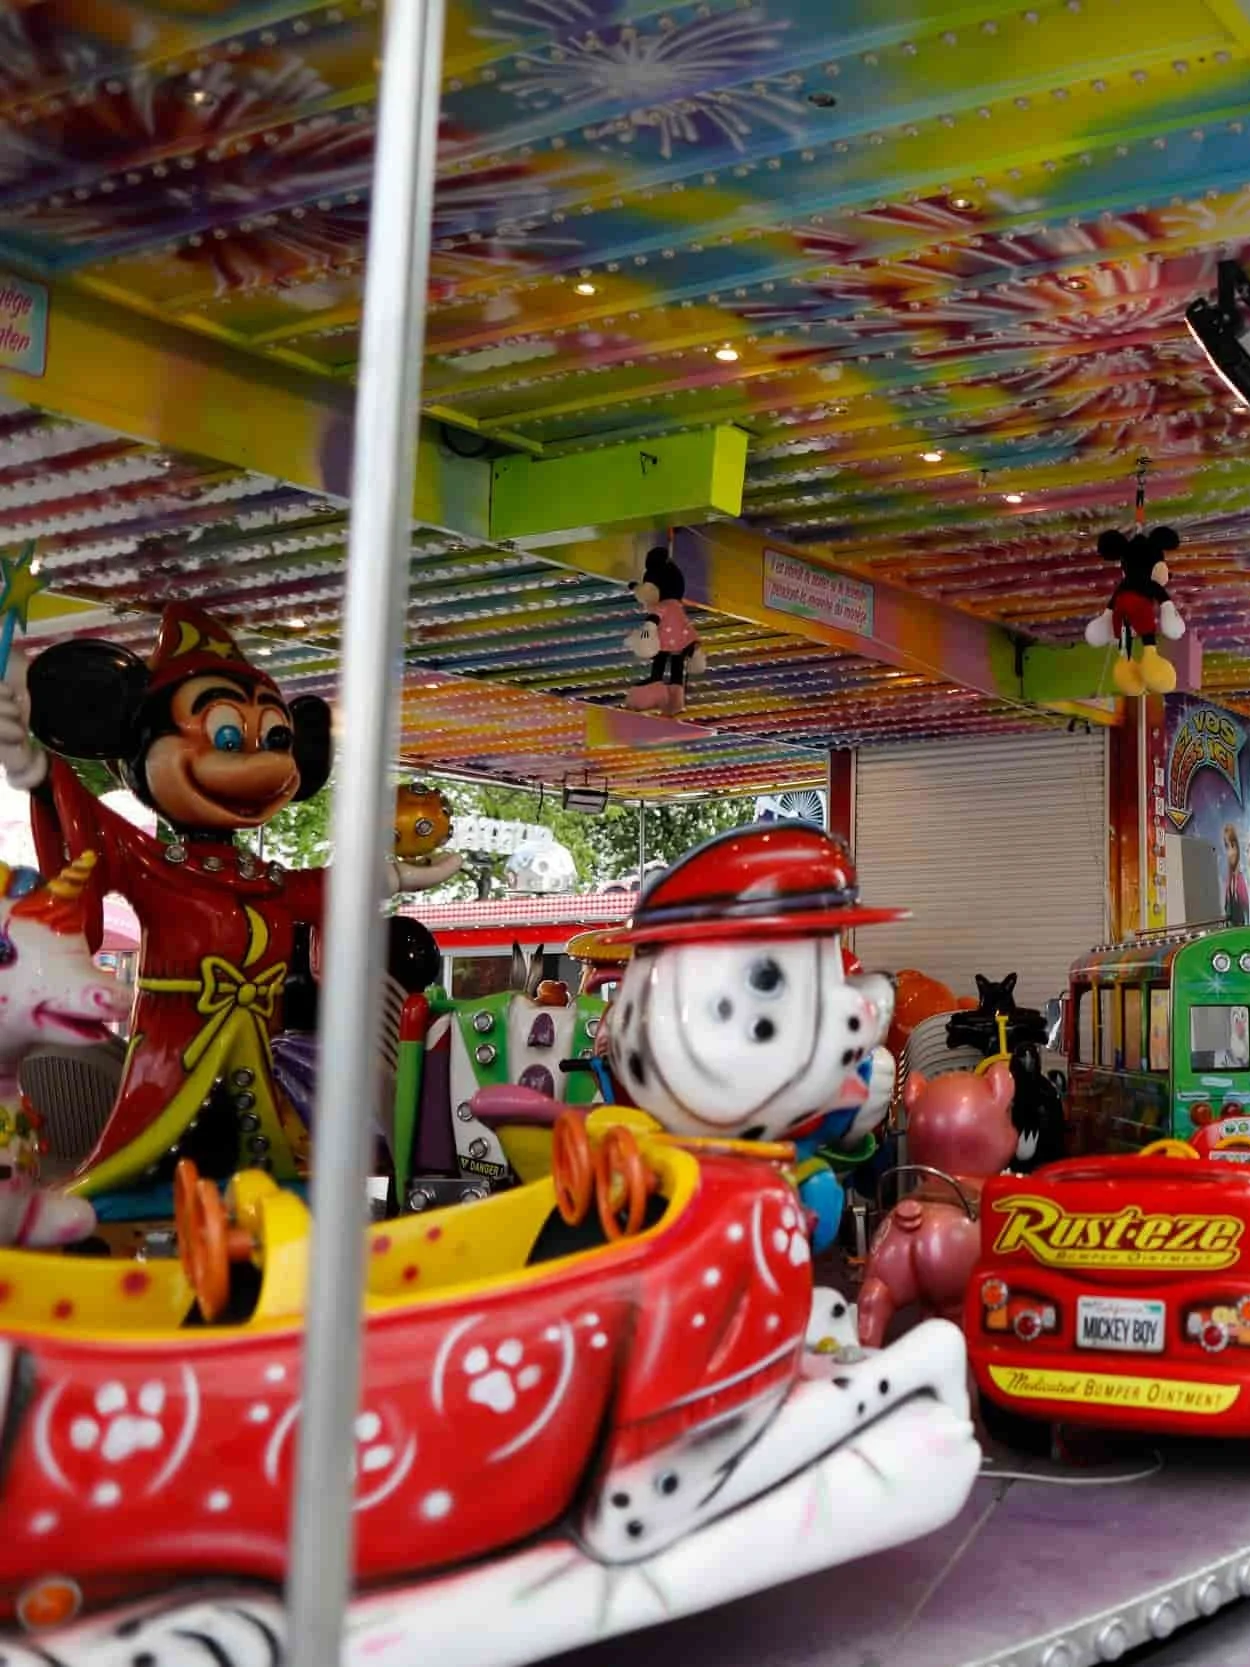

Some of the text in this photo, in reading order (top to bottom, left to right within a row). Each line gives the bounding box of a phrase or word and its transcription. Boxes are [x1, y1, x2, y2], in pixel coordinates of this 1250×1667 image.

[1083, 1315, 1158, 1345] MICKEY BOY
[1147, 1383, 1222, 1409] OINTMENT
